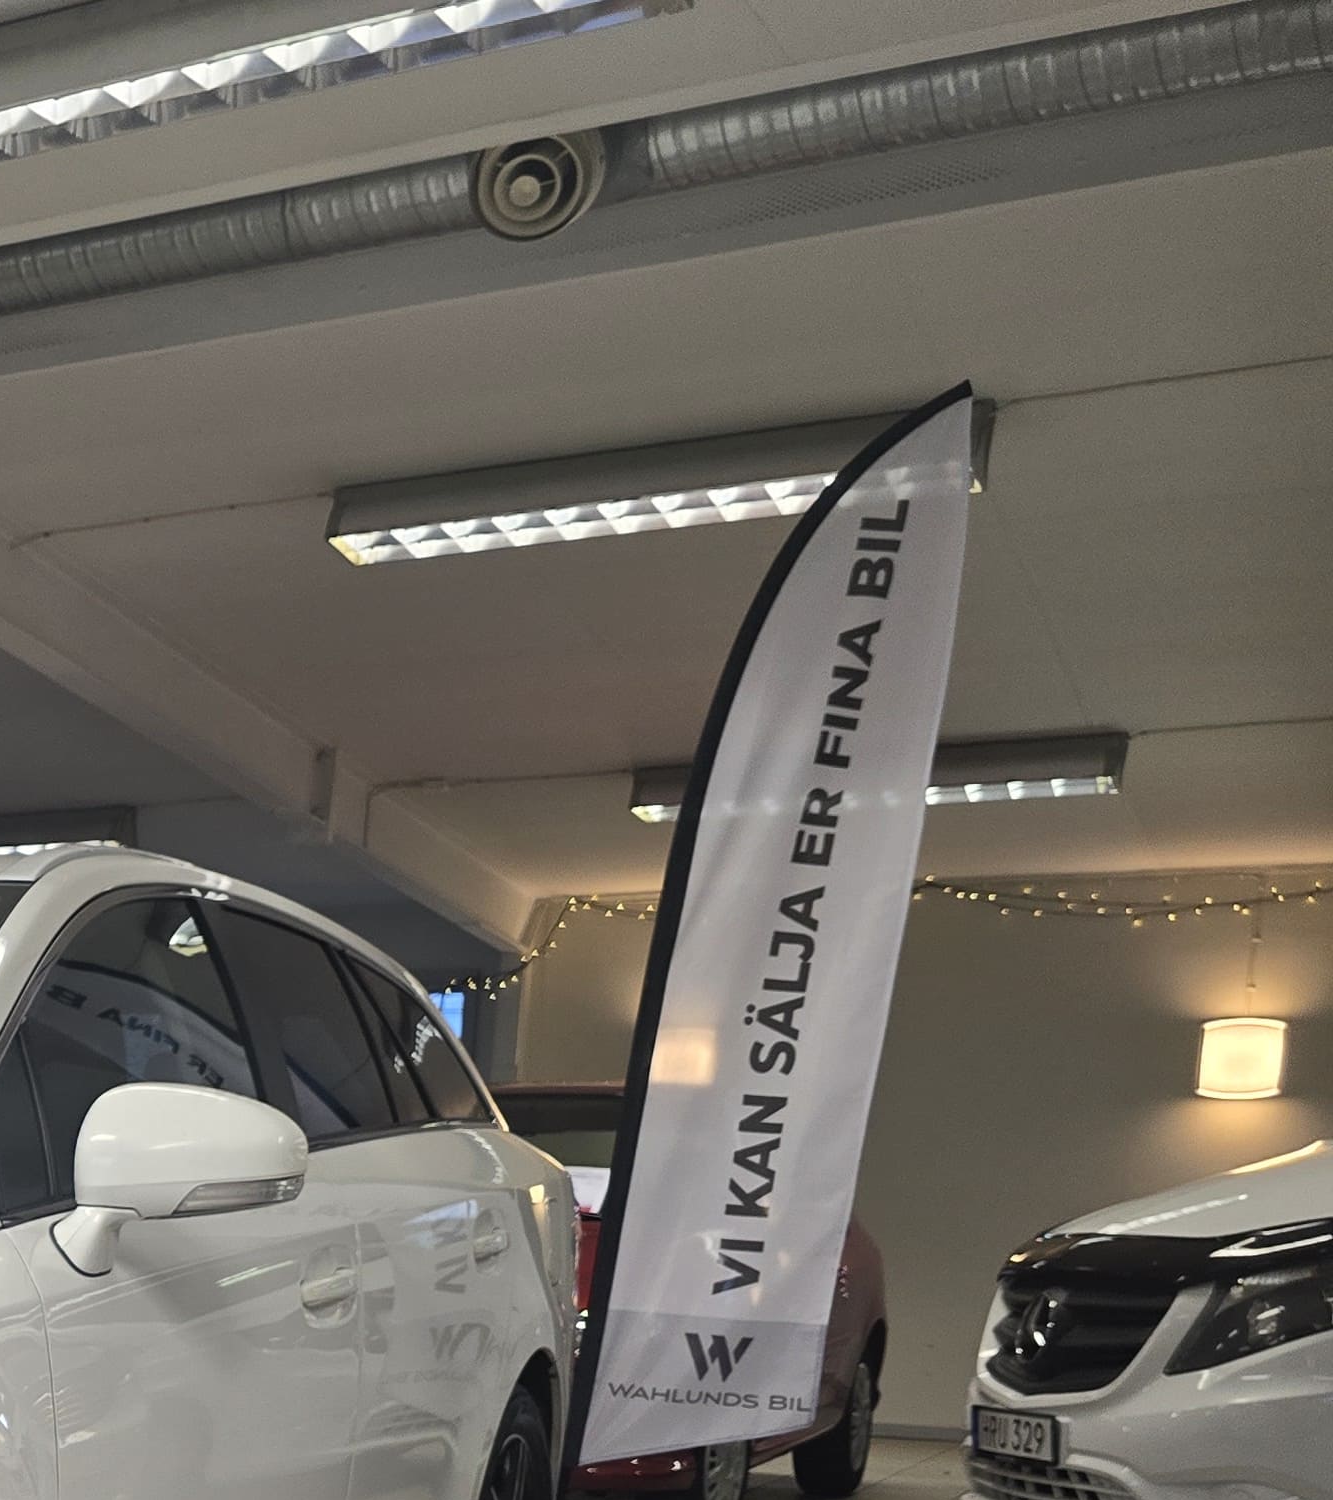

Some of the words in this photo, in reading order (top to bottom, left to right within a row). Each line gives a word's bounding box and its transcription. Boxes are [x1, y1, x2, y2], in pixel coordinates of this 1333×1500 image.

[846, 499, 910, 599] BIL
[813, 619, 882, 769] FINA
[790, 787, 844, 867] ER
[744, 886, 826, 1076] SÄLJA
[724, 1094, 789, 1218] KAN
[711, 1238, 766, 1295] VI
[608, 1381, 760, 1409] WAHLUNDS
[768, 1394, 813, 1412] BIL
[1011, 1418, 1045, 1454] 329
